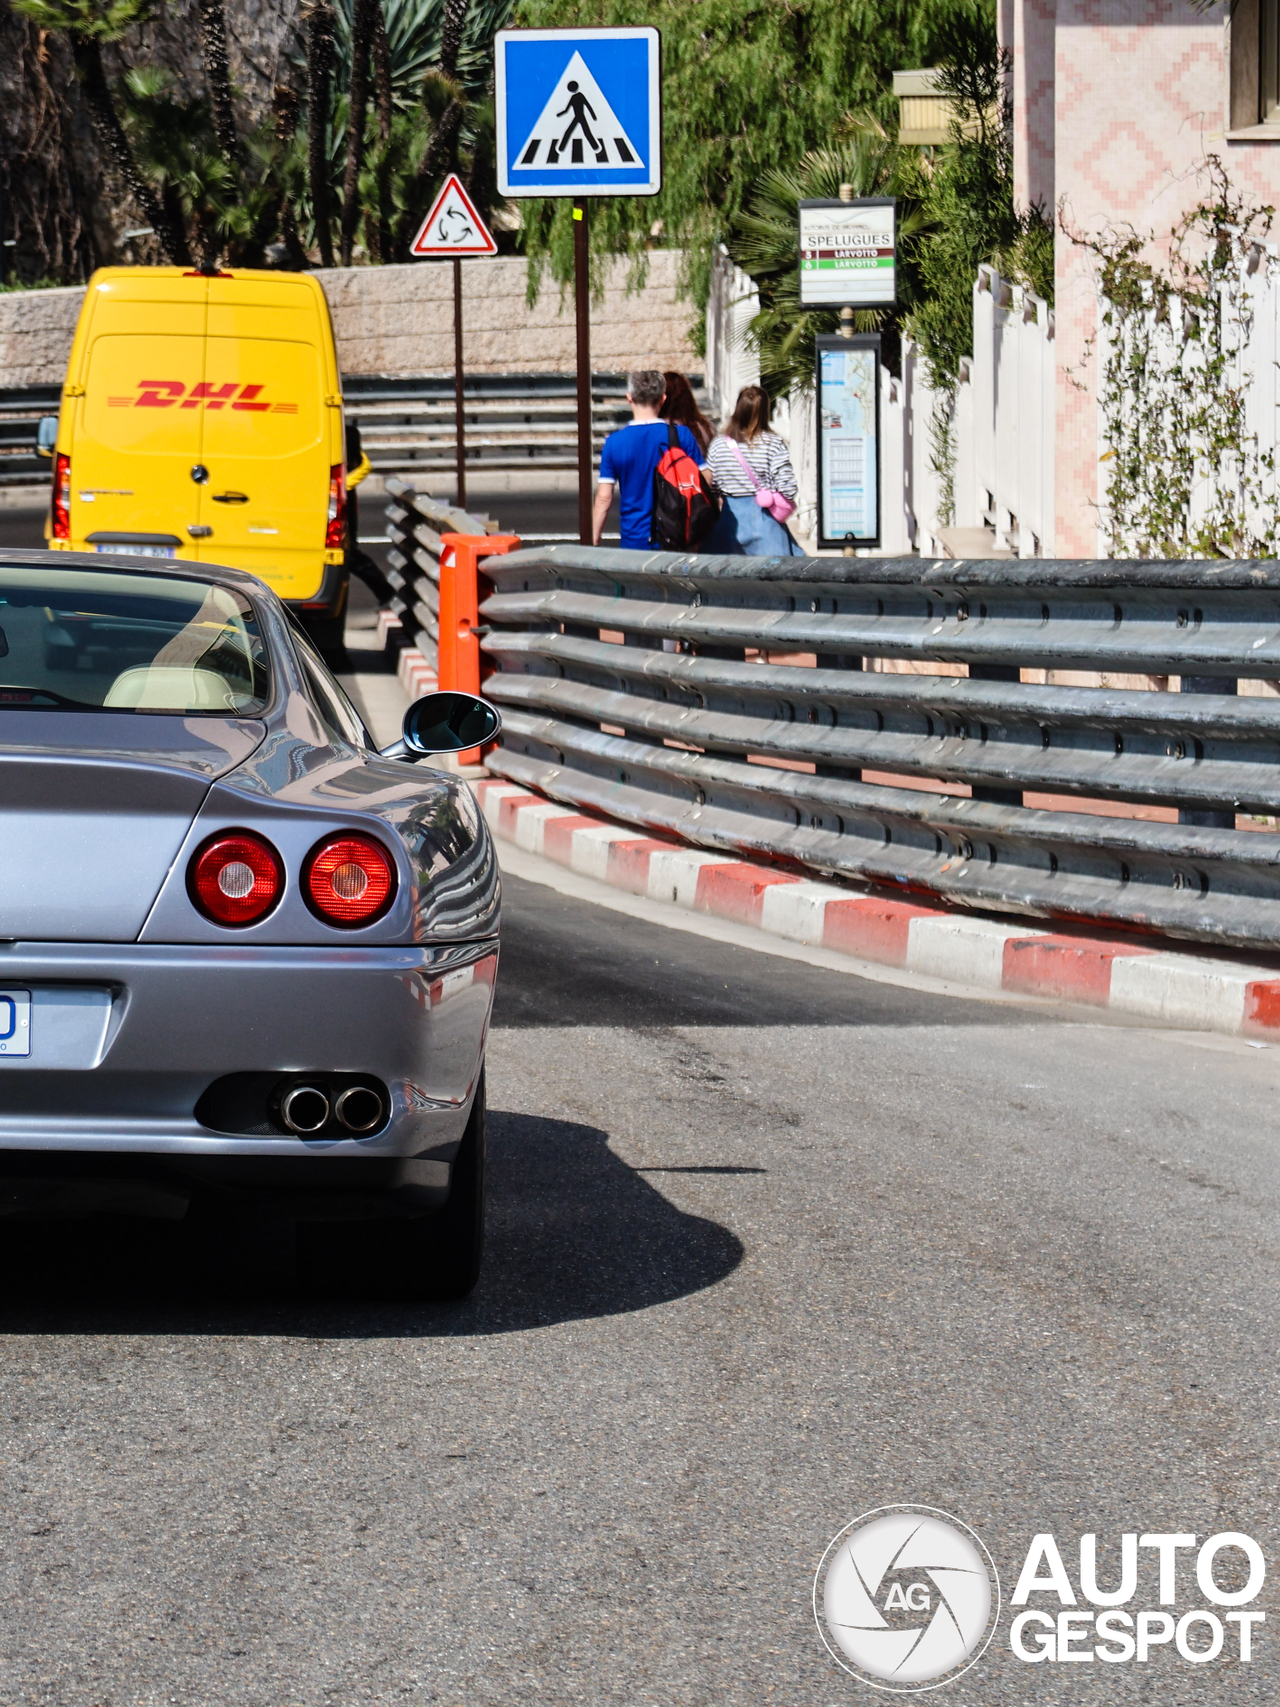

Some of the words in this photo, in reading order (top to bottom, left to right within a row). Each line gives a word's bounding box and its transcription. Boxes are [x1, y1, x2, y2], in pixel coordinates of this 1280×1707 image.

[808, 234, 890, 247] SPELUGUES
[805, 251, 812, 259] 5
[834, 249, 878, 258] LARVOTTO
[805, 261, 812, 270] 6
[834, 259, 878, 268] LARVOTTO
[134, 380, 273, 412] DHL
